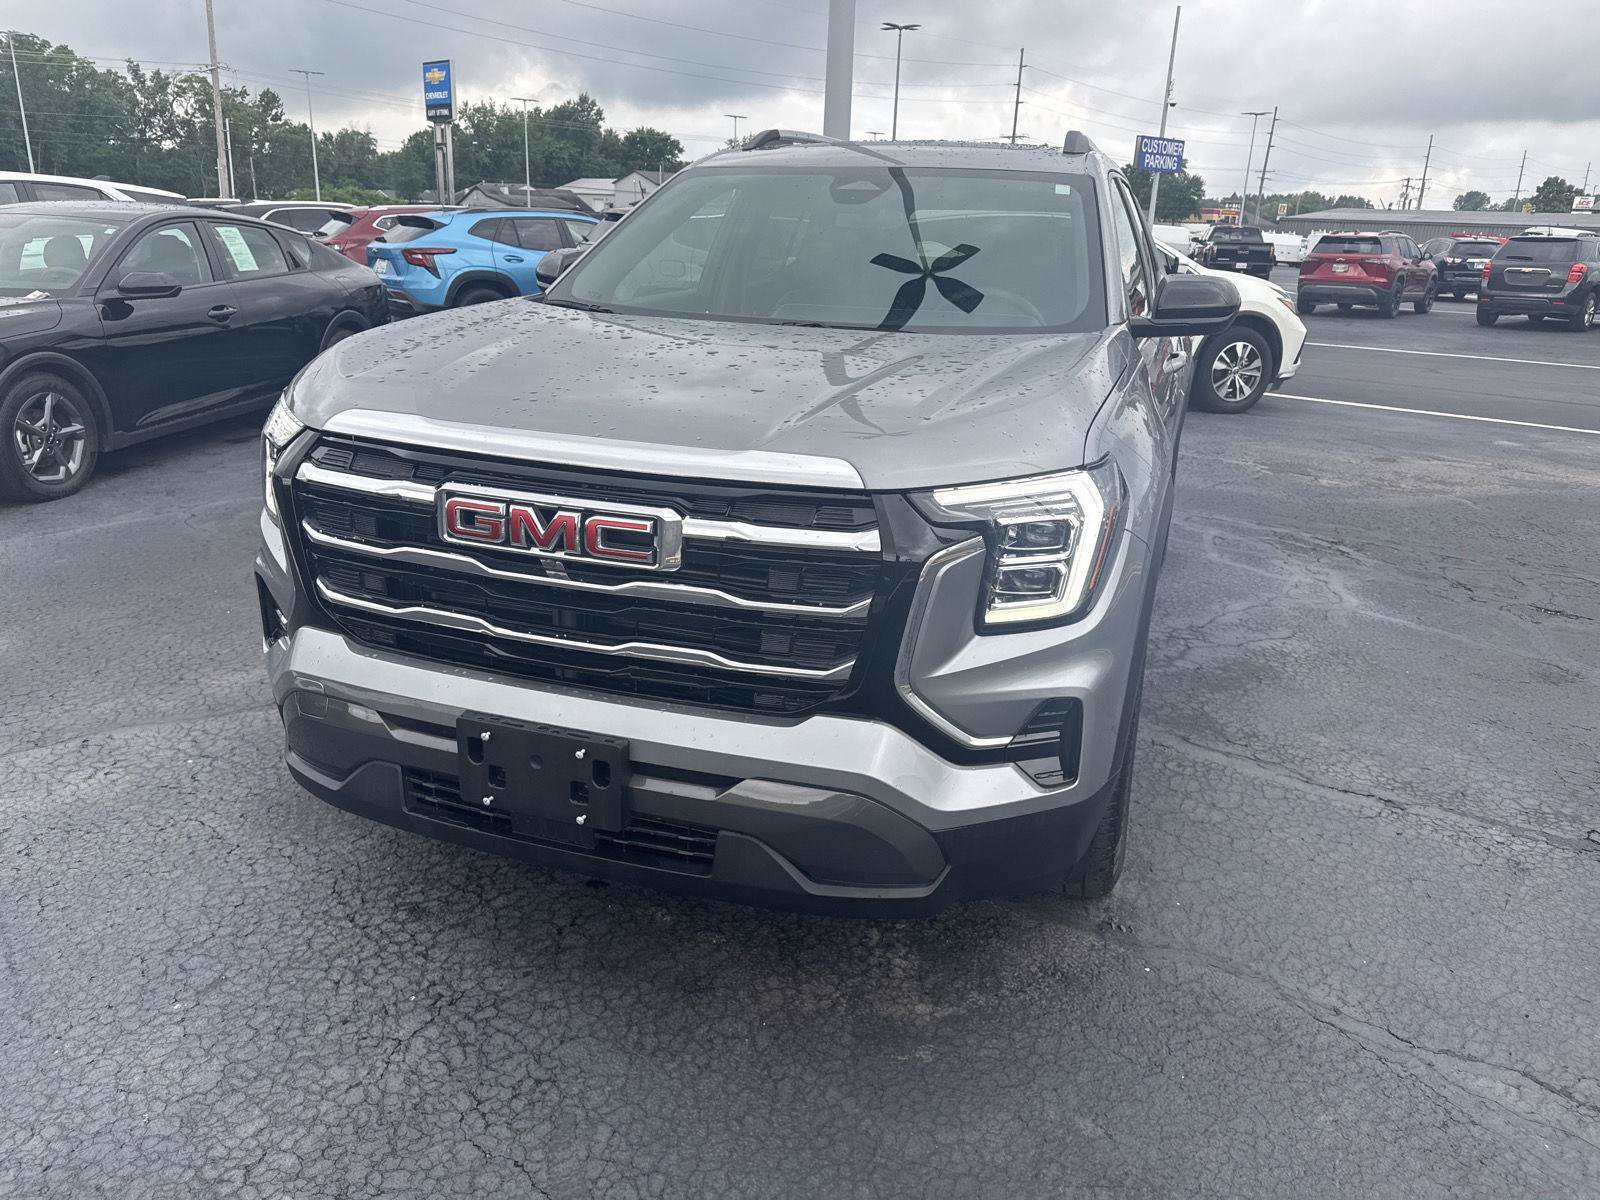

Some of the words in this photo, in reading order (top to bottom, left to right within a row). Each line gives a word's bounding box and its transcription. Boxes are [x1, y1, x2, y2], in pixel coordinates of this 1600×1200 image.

[1142, 138, 1183, 156] CUSTOMER
[1144, 153, 1178, 170] PARKING
[445, 497, 654, 564] GMC
